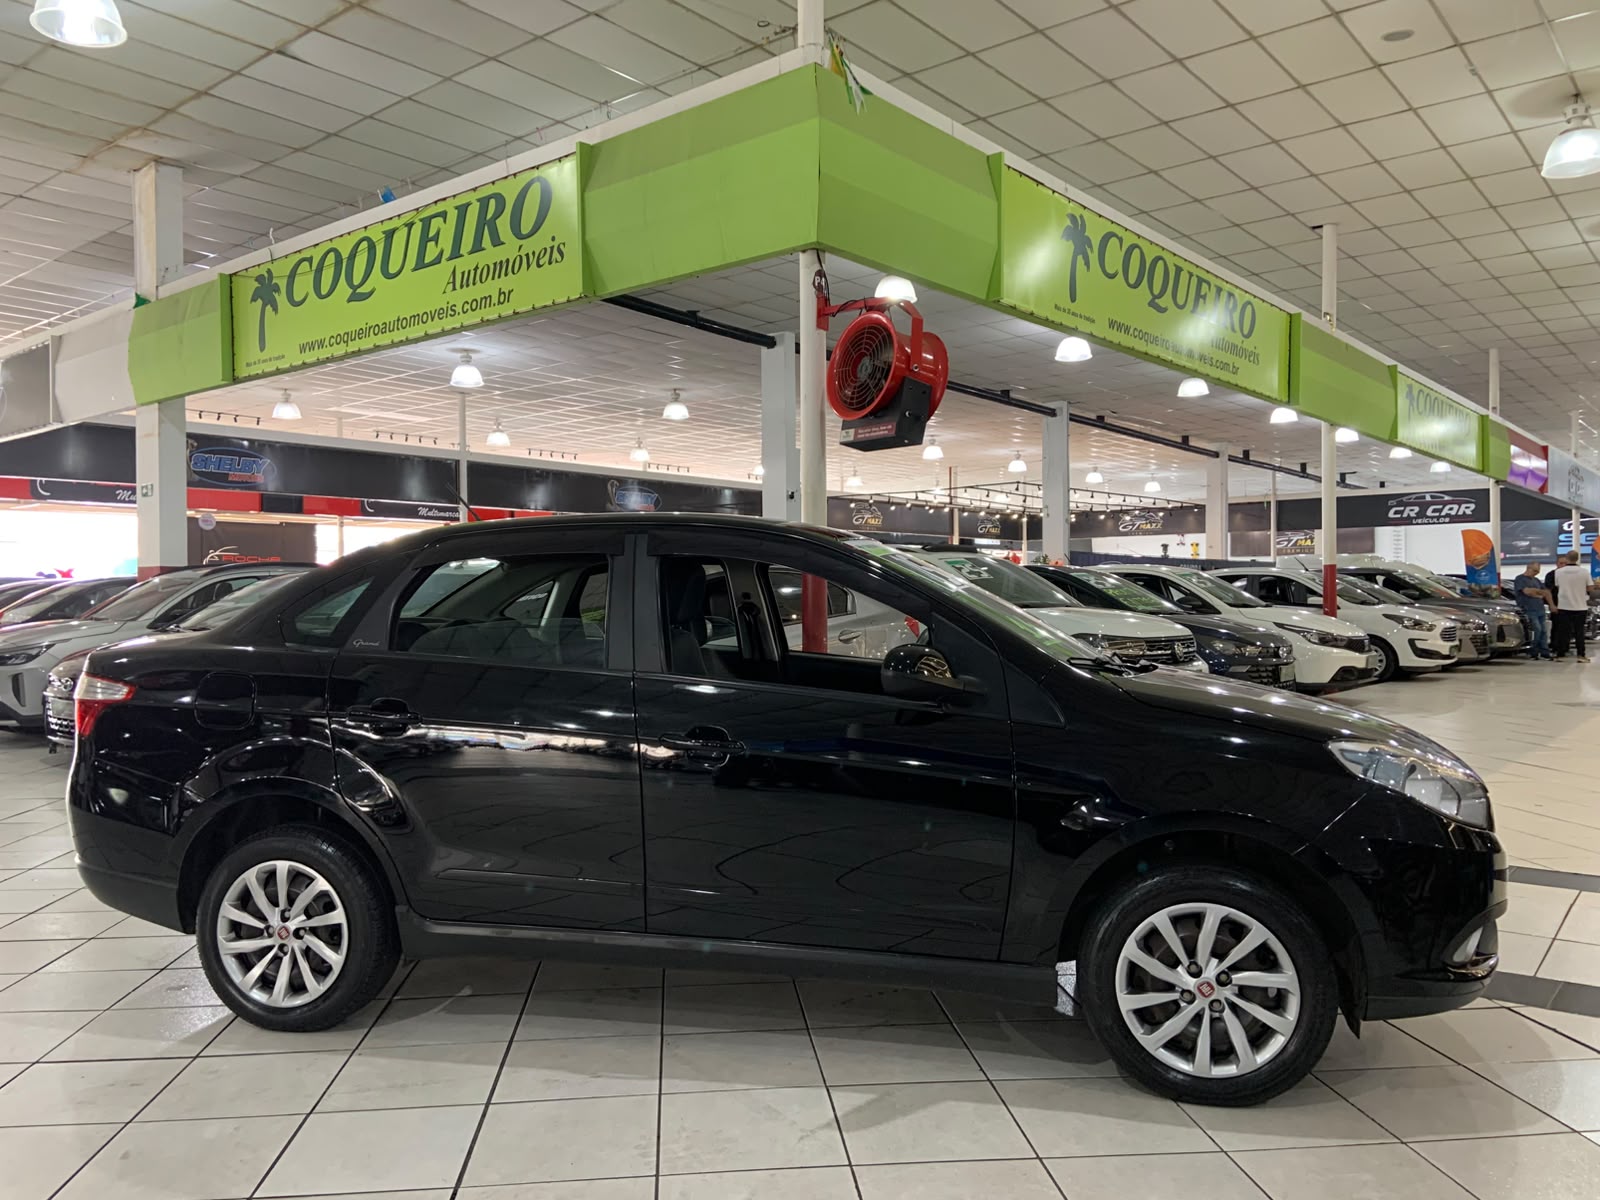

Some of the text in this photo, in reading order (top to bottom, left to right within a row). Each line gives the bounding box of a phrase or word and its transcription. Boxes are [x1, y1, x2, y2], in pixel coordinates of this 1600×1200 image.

[285, 175, 553, 308] COQUEIRO
[442, 235, 566, 294] Automóveis
[1098, 231, 1256, 339] COQUEIRO
[298, 287, 514, 354] www.coqueiroautomoveis.com.br
[1209, 335, 1260, 366] utomóveis
[191, 453, 271, 475] SHELBY
[1119, 521, 1146, 531] GT
[1388, 503, 1476, 518] CR CAR
